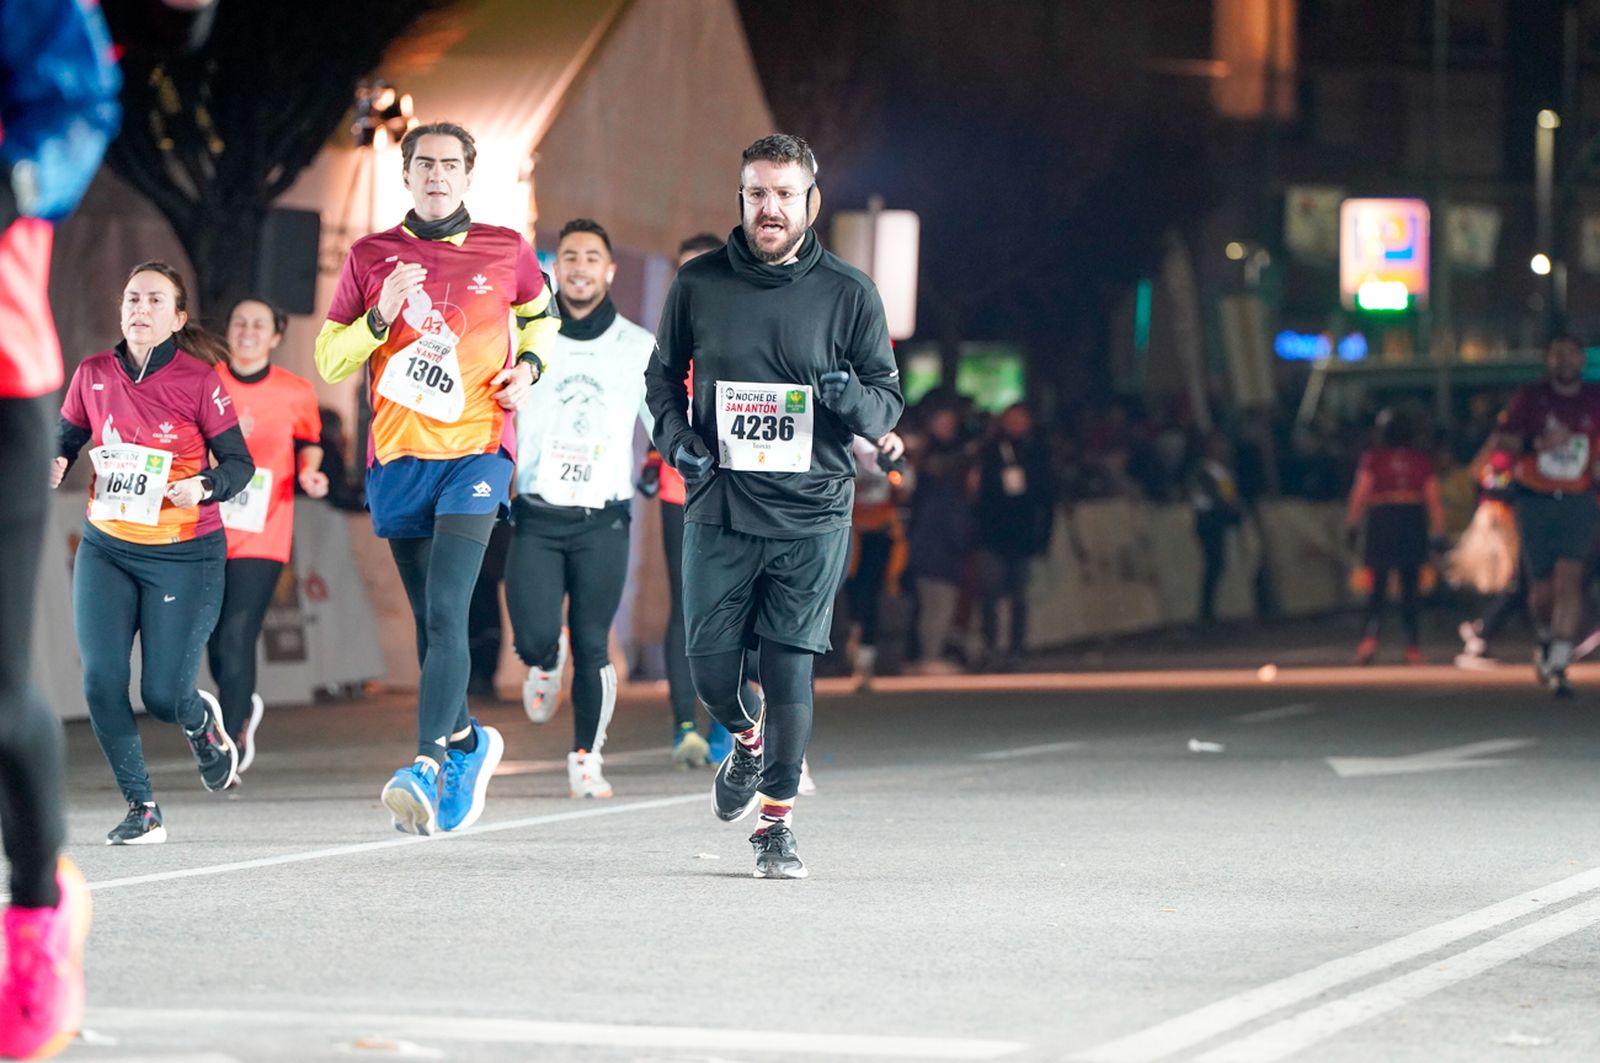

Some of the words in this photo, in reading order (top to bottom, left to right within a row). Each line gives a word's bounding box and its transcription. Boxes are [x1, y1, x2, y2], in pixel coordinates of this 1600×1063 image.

[421, 316, 443, 335] 43
[406, 356, 454, 393] 1305
[735, 392, 764, 402] NOCHE
[766, 393, 777, 402] DE
[725, 402, 742, 412] SAN
[731, 415, 794, 441] 4236
[560, 463, 592, 481] 250
